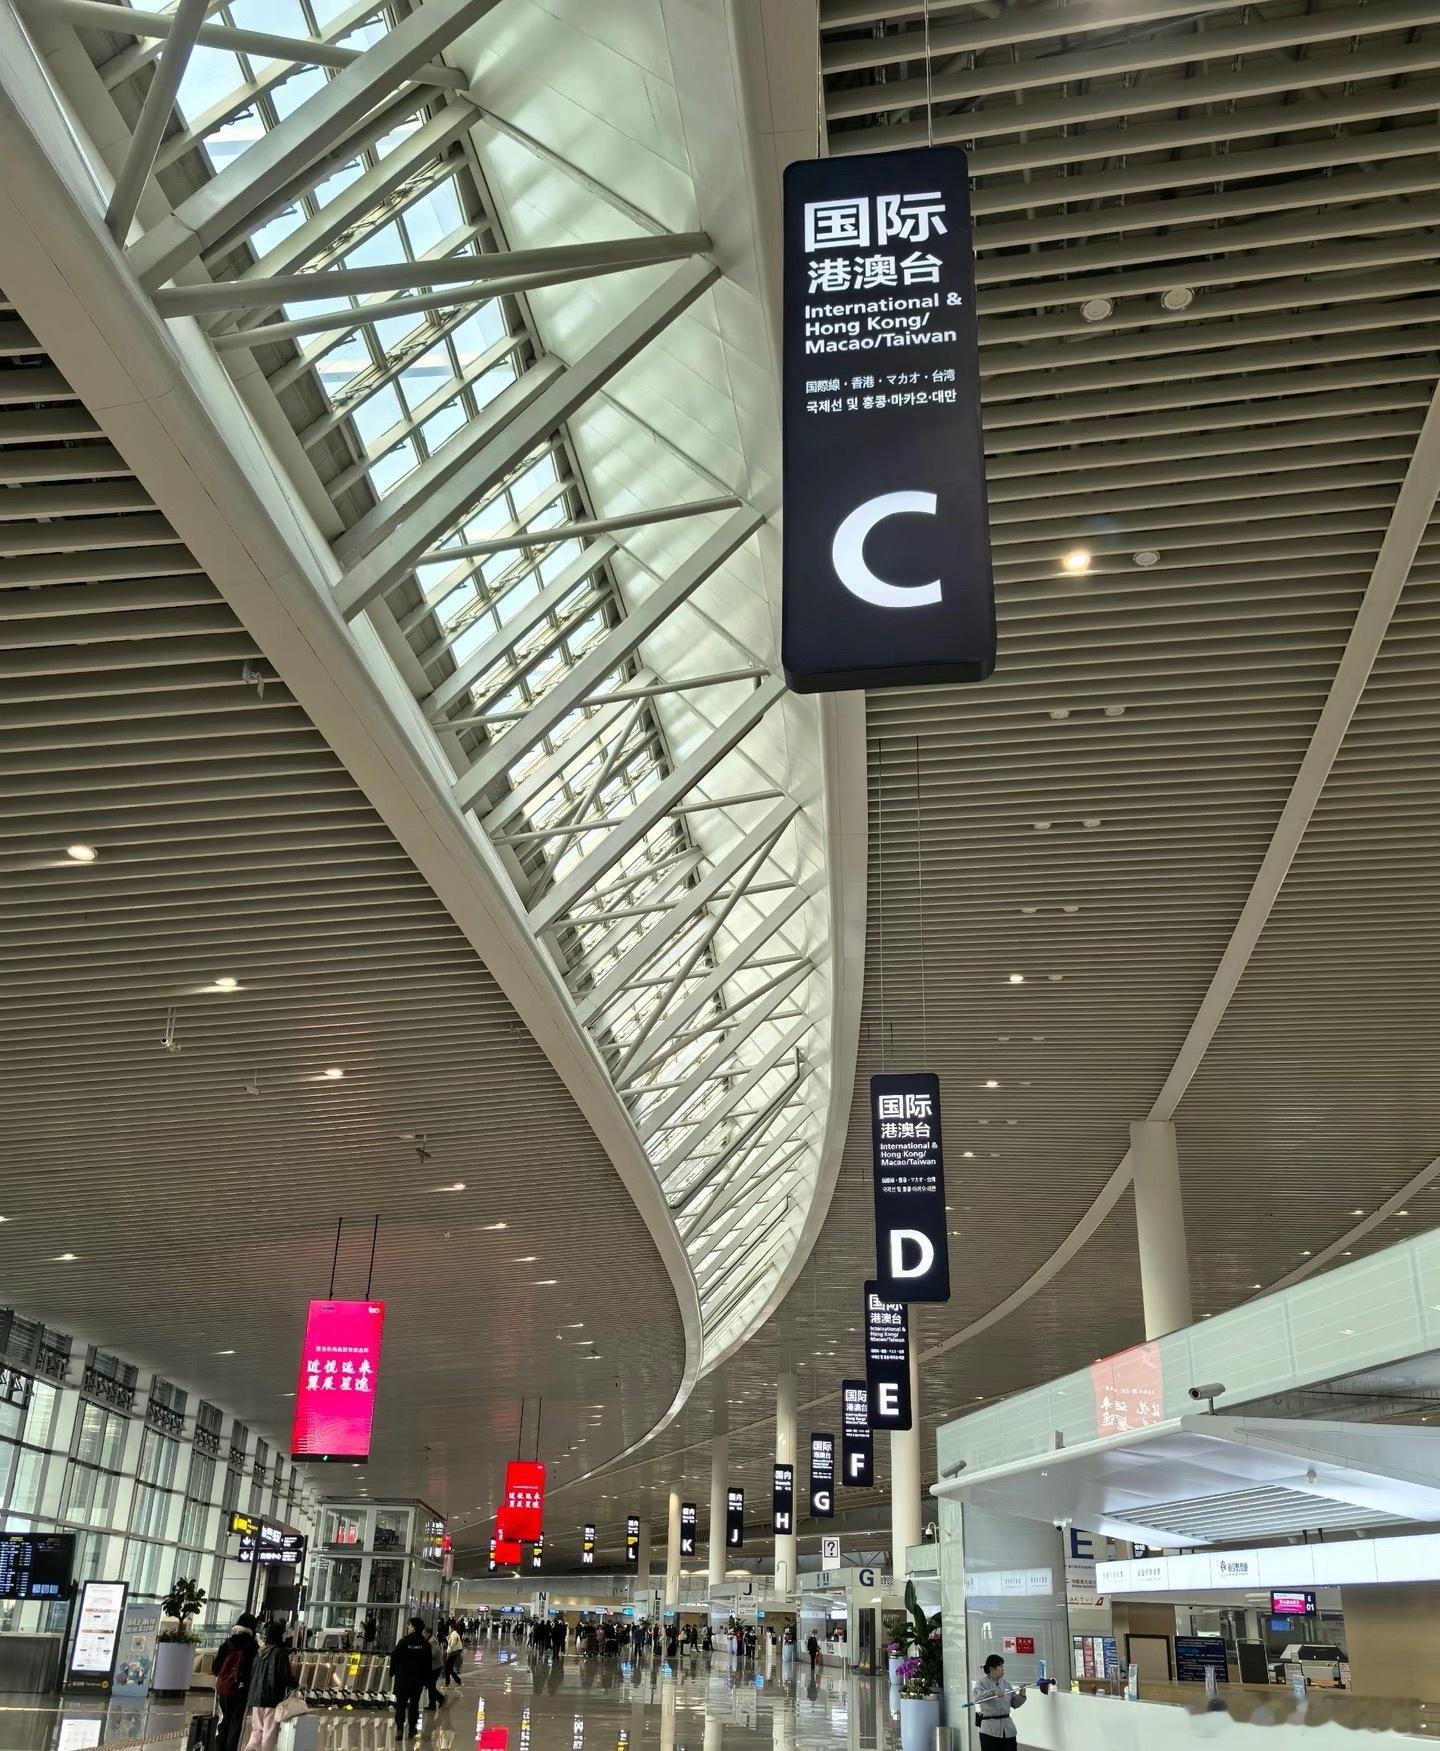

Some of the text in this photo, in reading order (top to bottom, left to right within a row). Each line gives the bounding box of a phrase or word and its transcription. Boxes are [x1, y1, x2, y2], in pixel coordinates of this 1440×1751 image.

[804, 191, 948, 253] 国际
[807, 251, 943, 294] 港澳台
[805, 292, 962, 319] International &
[805, 312, 929, 337] Hong Kong/
[805, 329, 957, 355] Macao/Taiwan
[806, 397, 842, 414] 국제선
[846, 397, 858, 412] 및
[832, 490, 942, 608] C
[878, 1094, 932, 1120] 国际
[881, 1122, 931, 1139] 港澳台
[880, 1142, 930, 1150] International
[881, 1150, 926, 1159] Hong Kong/
[881, 1158, 936, 1166] Macao/Taiwan
[890, 1229, 934, 1279] D
[870, 1313, 902, 1325] 港澳台
[879, 1383, 899, 1415] E
[851, 1453, 865, 1477] F
[814, 1491, 830, 1510] G
[775, 1512, 789, 1529] H
[731, 1529, 738, 1542] J
[1070, 1528, 1094, 1559] E
[628, 1547, 635, 1559] L
[682, 1539, 692, 1552] K
[533, 1557, 541, 1567] N
[583, 1552, 593, 1563] M
[859, 1568, 874, 1587] G
[539, 1592, 546, 1600] N
[655, 1590, 661, 1600] L
[743, 1582, 752, 1596] J
[1306, 1603, 1314, 1611] 01
